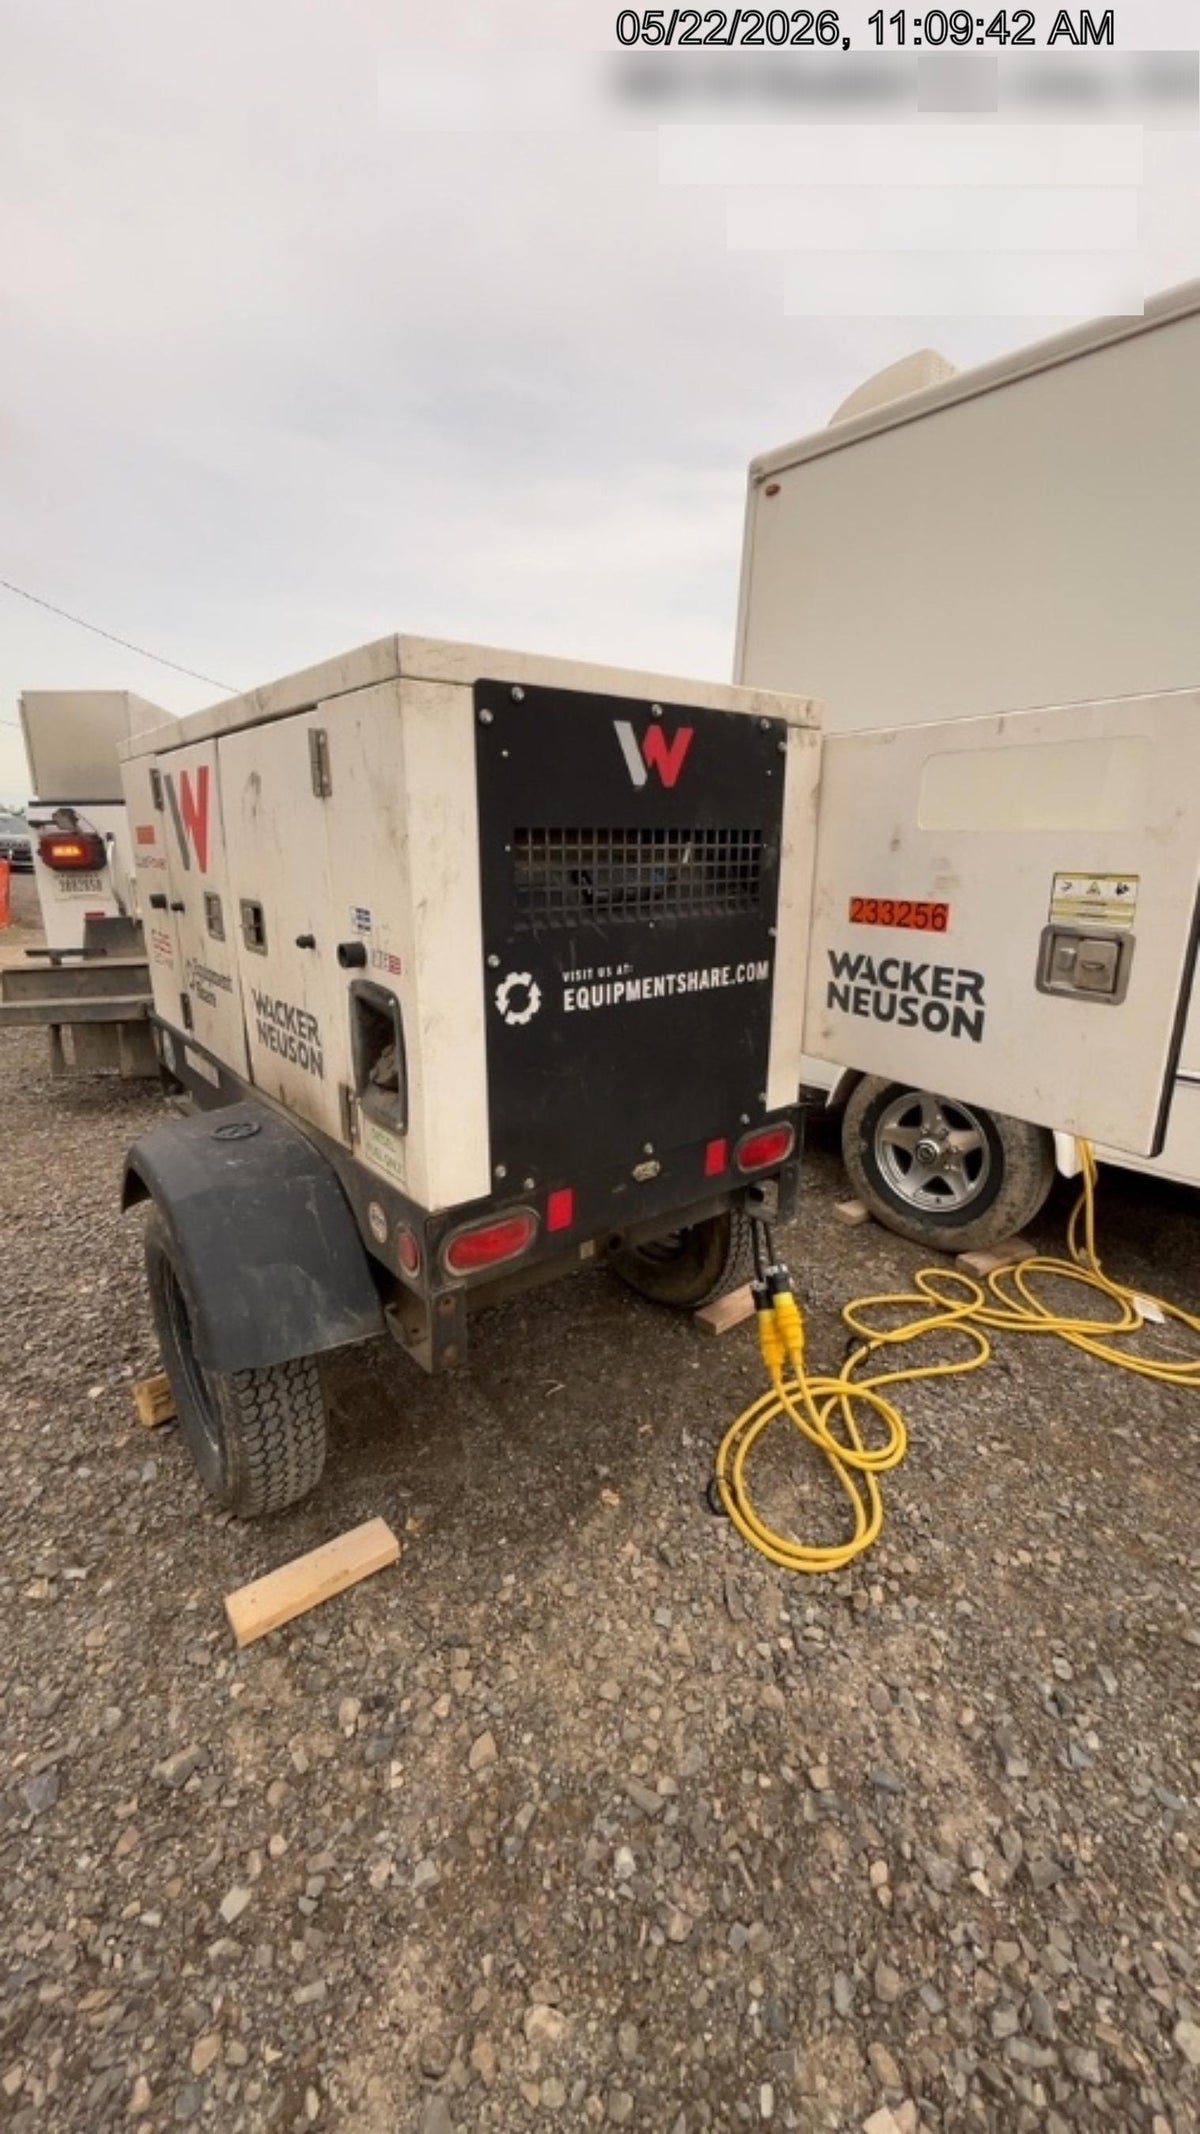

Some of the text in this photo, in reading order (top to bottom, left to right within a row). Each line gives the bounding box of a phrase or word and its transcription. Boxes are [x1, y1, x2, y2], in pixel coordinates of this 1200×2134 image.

[851, 898, 948, 931] 233256
[562, 967, 594, 982] VISIT
[597, 965, 613, 978] US
[563, 960, 769, 1013] EQUIPMENTSHARE.COM
[827, 950, 986, 1006] WACKER
[252, 988, 322, 1048] WACKER
[827, 981, 985, 1043] NEUSON
[256, 1017, 324, 1080] NEUSON
